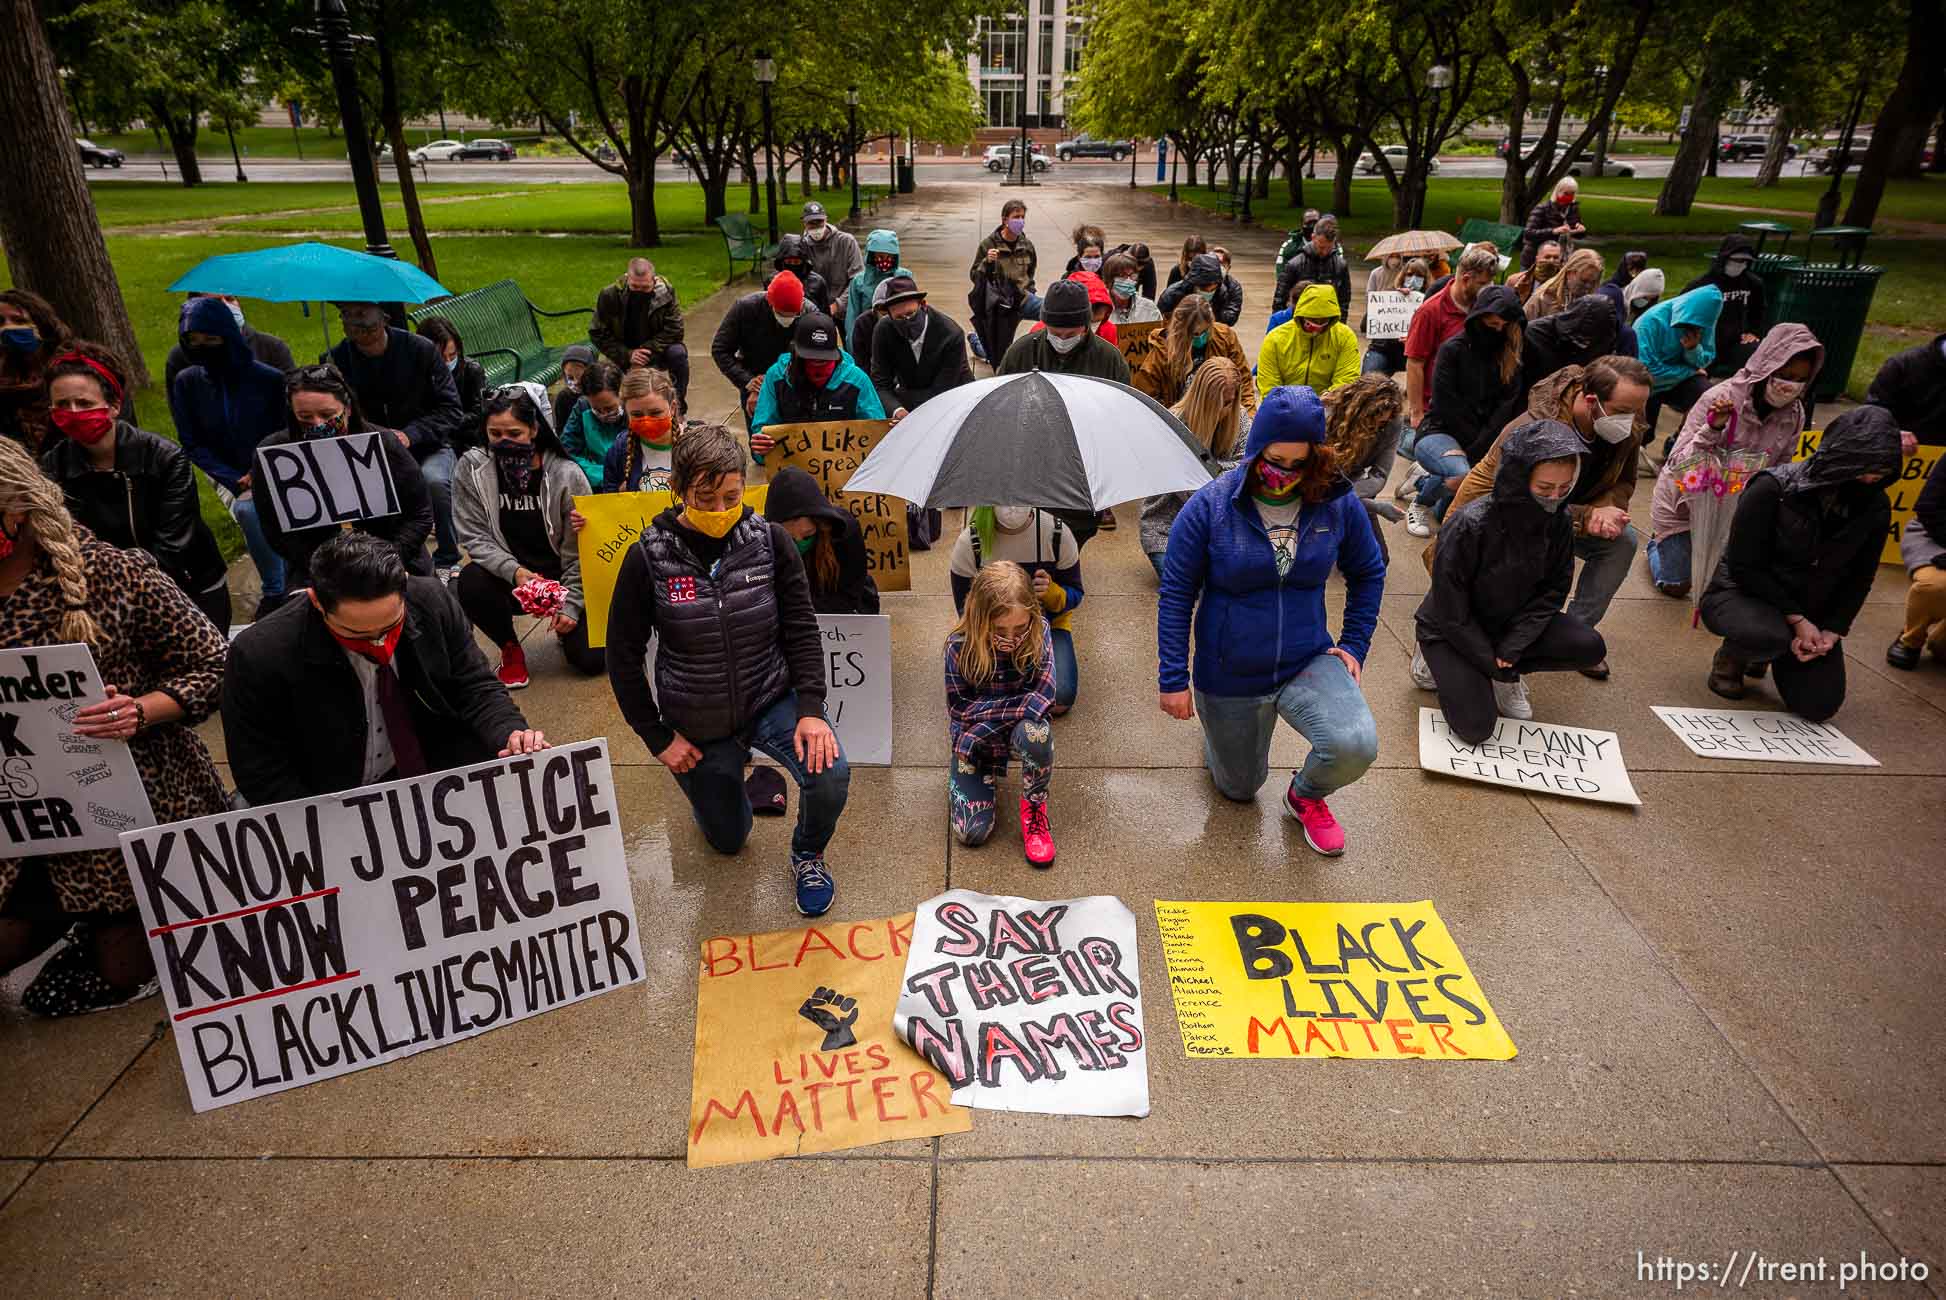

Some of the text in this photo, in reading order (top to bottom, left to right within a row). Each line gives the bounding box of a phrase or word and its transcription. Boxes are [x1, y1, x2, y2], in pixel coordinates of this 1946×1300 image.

[822, 429, 870, 451] Like
[262, 433, 400, 530] BLM
[597, 523, 638, 564] Black
[670, 590, 696, 602] SLC
[1518, 725, 1610, 760] MANY
[1664, 713, 1741, 732] THEY
[1447, 738, 1587, 772] WEREN'T
[1687, 733, 1852, 759] BREATHE
[1450, 757, 1600, 793] FILMED
[131, 746, 612, 926] KNOW JUSTICE
[162, 834, 601, 1009] KNOW PEACE
[934, 902, 1068, 960] SAY
[704, 919, 912, 977] BLACK
[1230, 912, 1444, 980] BLACK
[906, 936, 1138, 1017] THEIR
[1171, 975, 1214, 985] Michael
[1174, 997, 1223, 1007] Terence
[1178, 1009, 1207, 1018] Alton
[1281, 974, 1486, 1025] LIVES
[906, 1001, 1144, 1090] NAMES
[1179, 1021, 1215, 1030] Botham
[1247, 1016, 1466, 1057] MATTER
[774, 1044, 891, 1085] LIVES
[1186, 1041, 1235, 1056] George
[693, 1071, 951, 1144] MATTER
